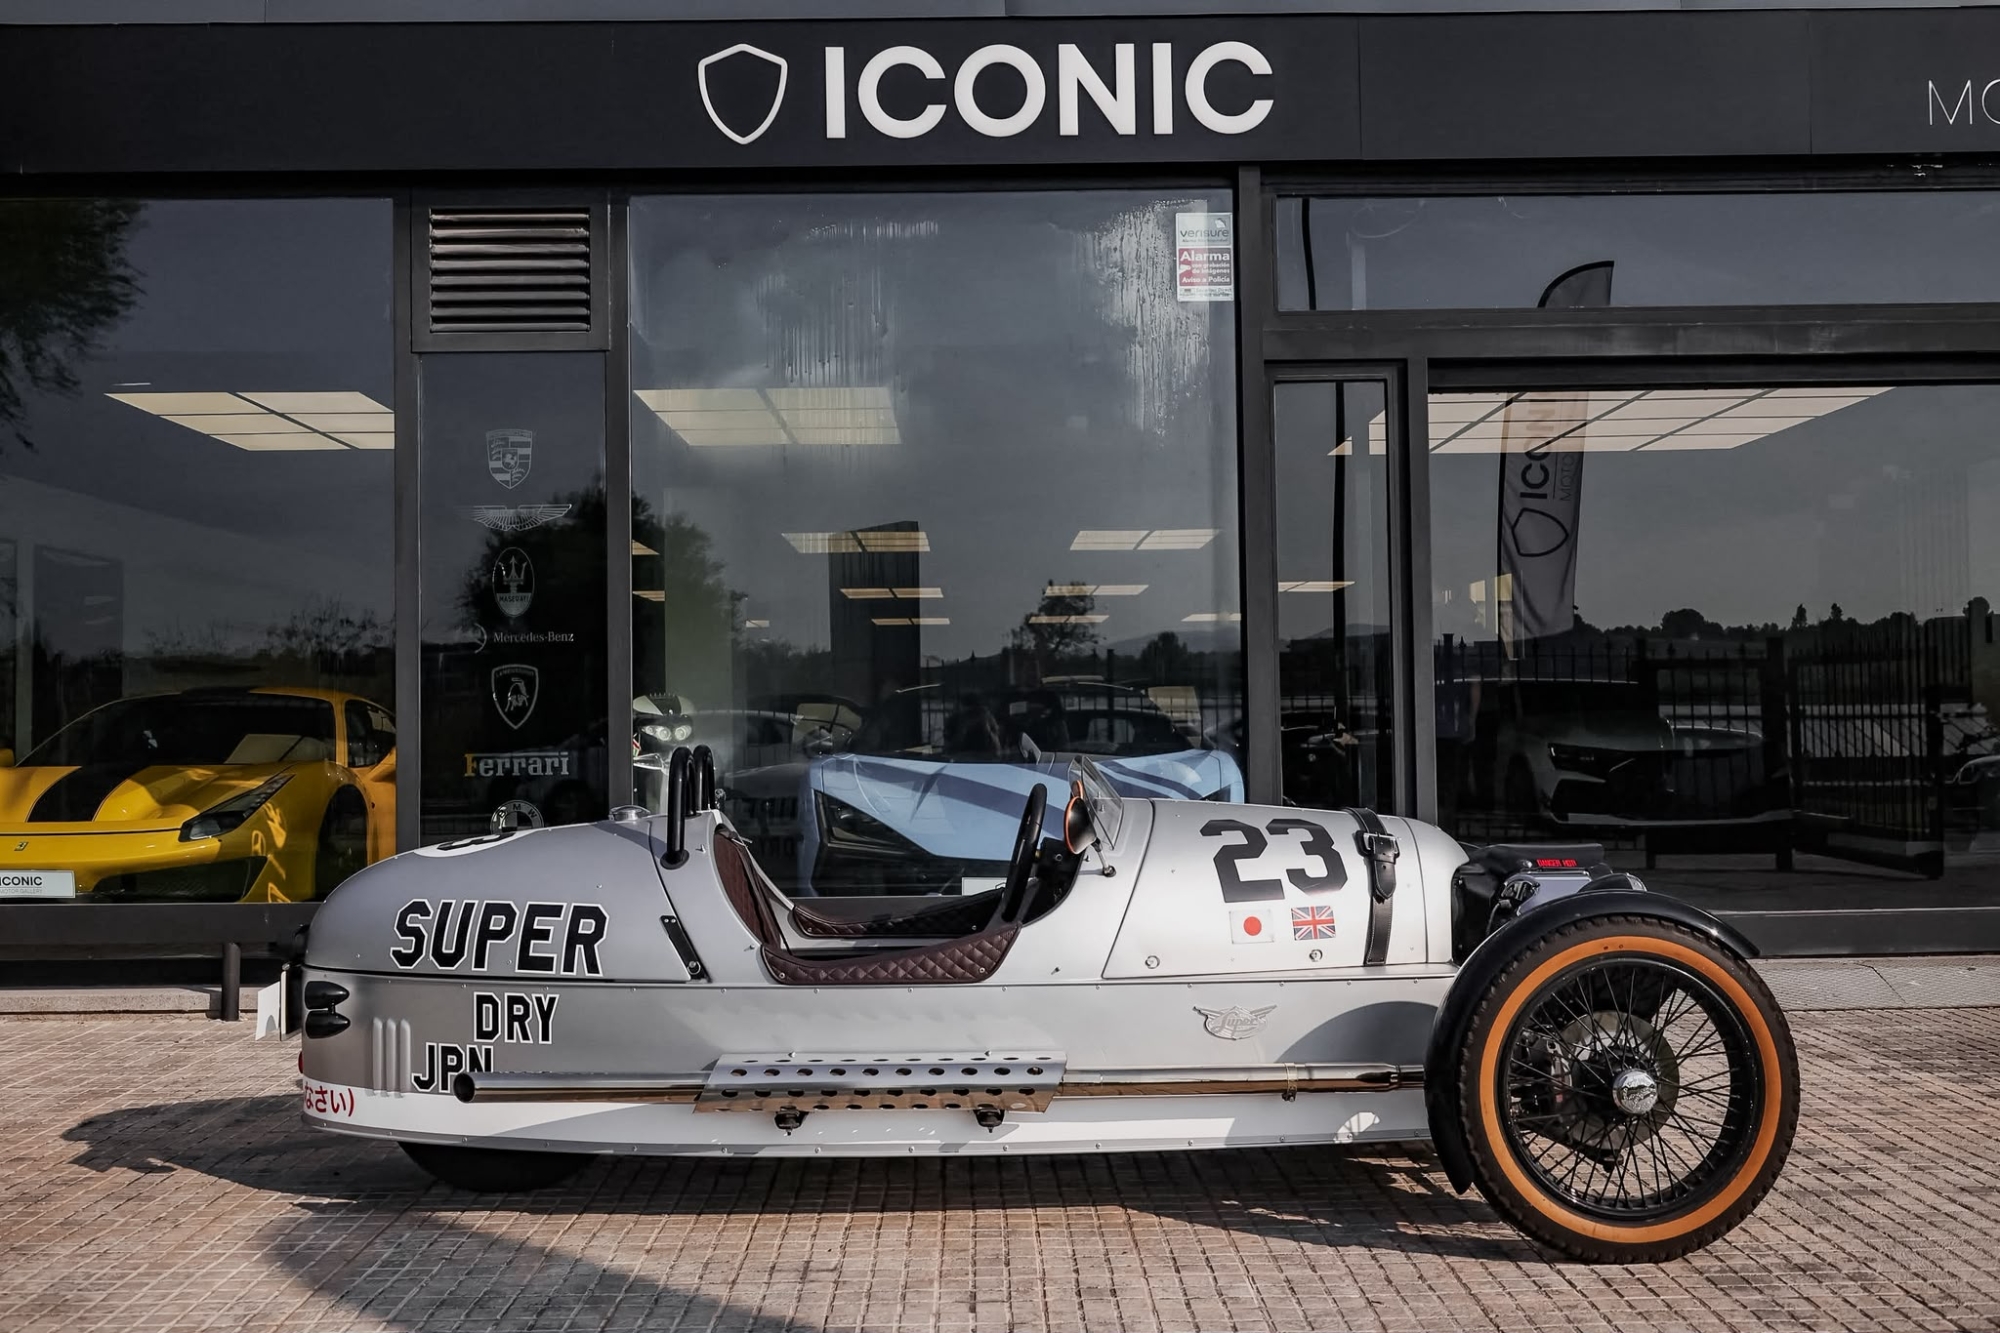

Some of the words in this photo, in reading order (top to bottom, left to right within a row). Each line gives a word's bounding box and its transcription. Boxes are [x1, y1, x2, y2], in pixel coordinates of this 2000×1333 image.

[825, 41, 1274, 139] ICONIC
[1180, 229, 1230, 238] verisure
[1180, 250, 1230, 261] Alarma
[493, 631, 574, 643] Mercedes-Benz
[464, 752, 569, 776] Ferrari
[1199, 819, 1348, 903] 23
[390, 899, 609, 976] SUPER
[473, 991, 559, 1044] DRY
[411, 1042, 494, 1093] JPN
